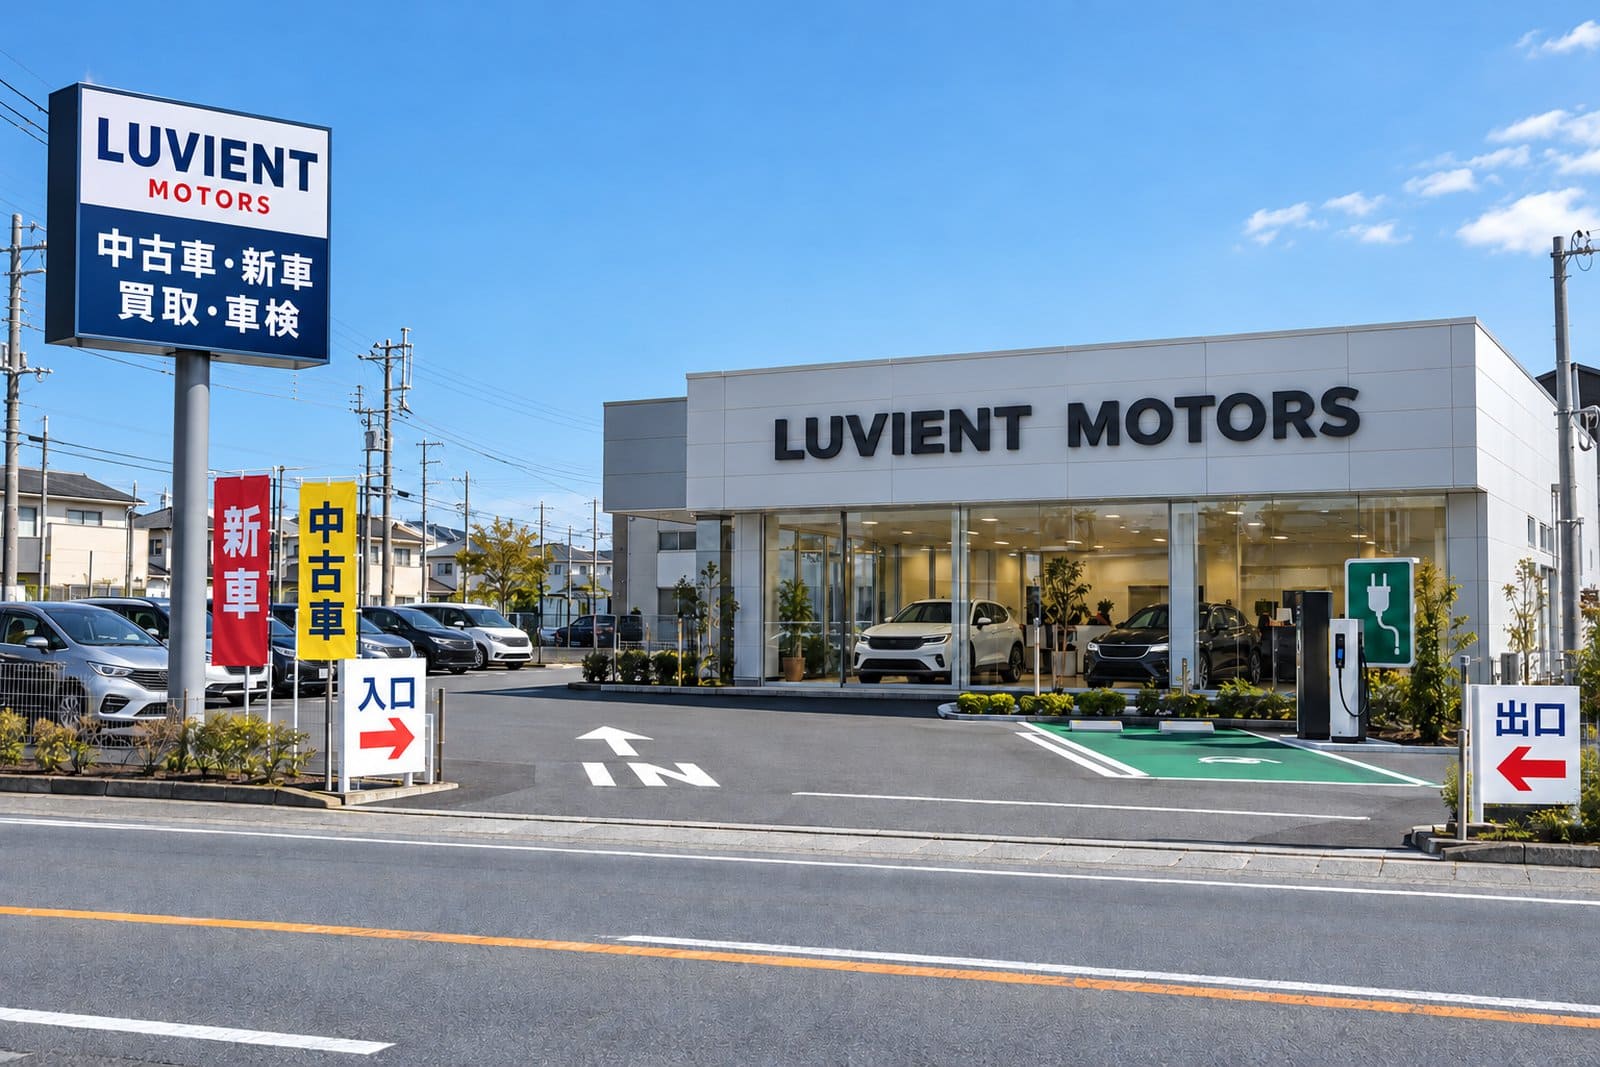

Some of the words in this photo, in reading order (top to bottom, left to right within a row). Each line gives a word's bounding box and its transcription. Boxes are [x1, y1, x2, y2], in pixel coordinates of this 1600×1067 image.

[97, 117, 319, 192] LUVIENT
[148, 178, 270, 215] MOTORS
[97, 228, 314, 291] 中古車・新車
[118, 281, 300, 339] 買取・車検
[774, 404, 1032, 461] LUVIENT
[1067, 386, 1361, 448] MOTORS
[222, 504, 261, 620] 新車
[308, 501, 346, 641] 中古車
[358, 676, 416, 713] 入口
[1495, 699, 1566, 737] 出口
[582, 762, 721, 787] IN
